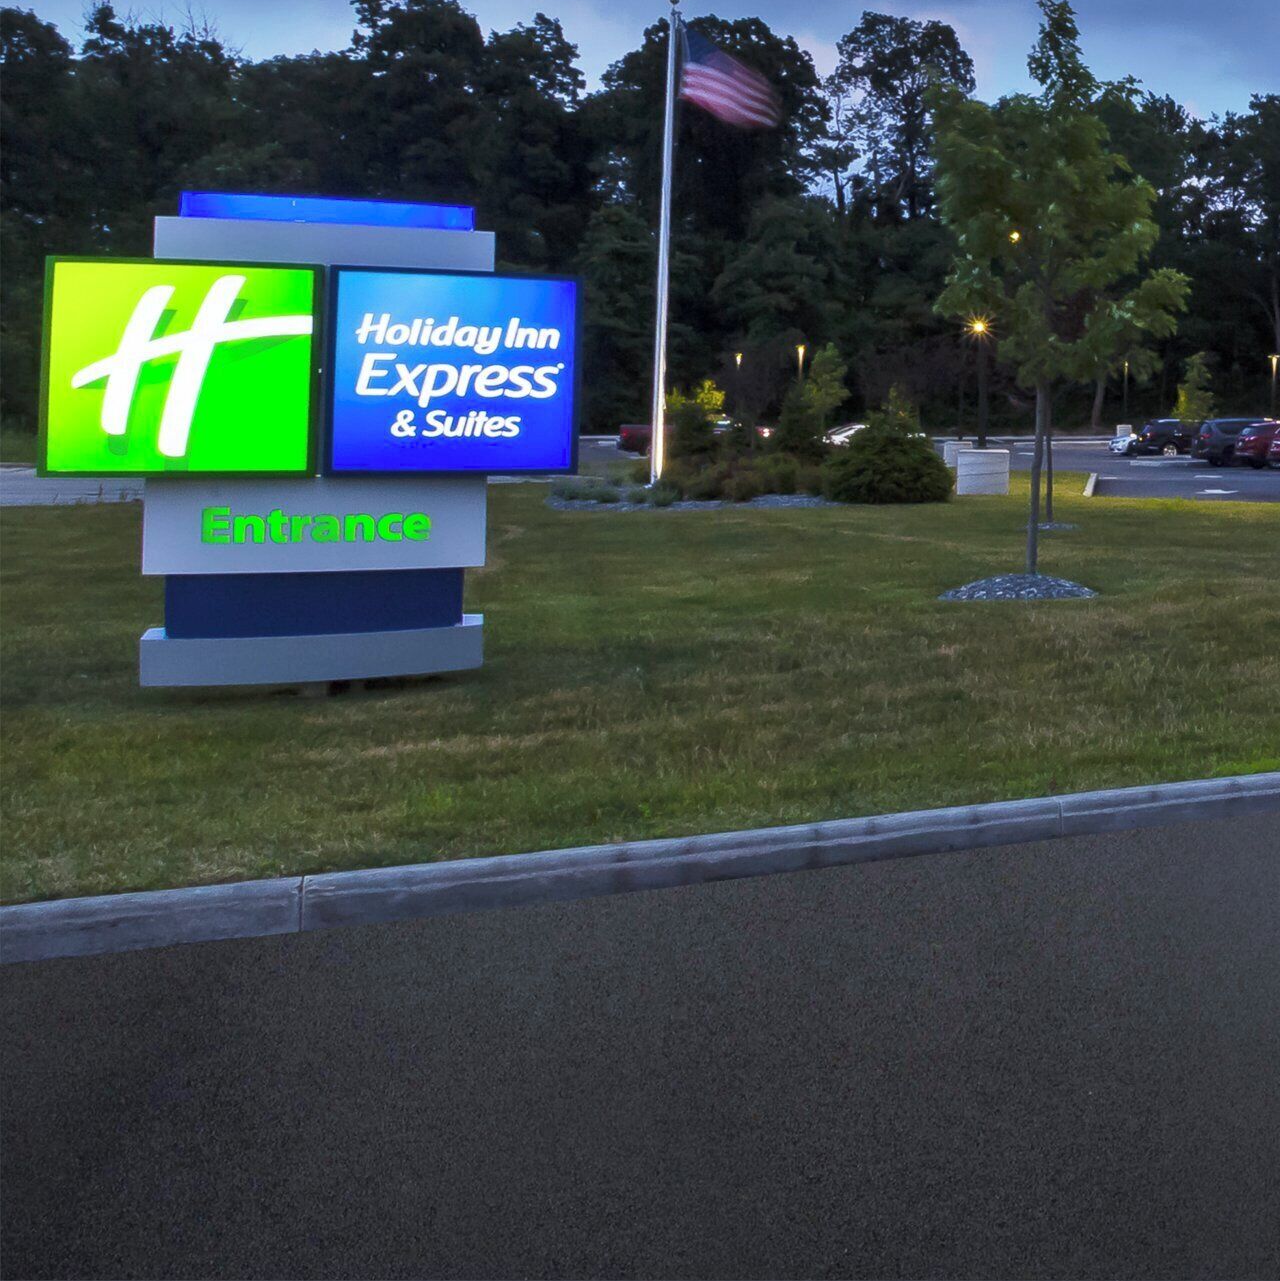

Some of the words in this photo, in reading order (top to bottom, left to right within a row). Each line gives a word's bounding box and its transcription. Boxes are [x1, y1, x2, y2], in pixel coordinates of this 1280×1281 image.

[355, 313, 502, 355] Holiday
[504, 317, 560, 350] Inn
[355, 353, 560, 408] Express
[390, 410, 417, 437] &
[422, 410, 521, 437] Suites
[201, 506, 432, 544] Entrance
